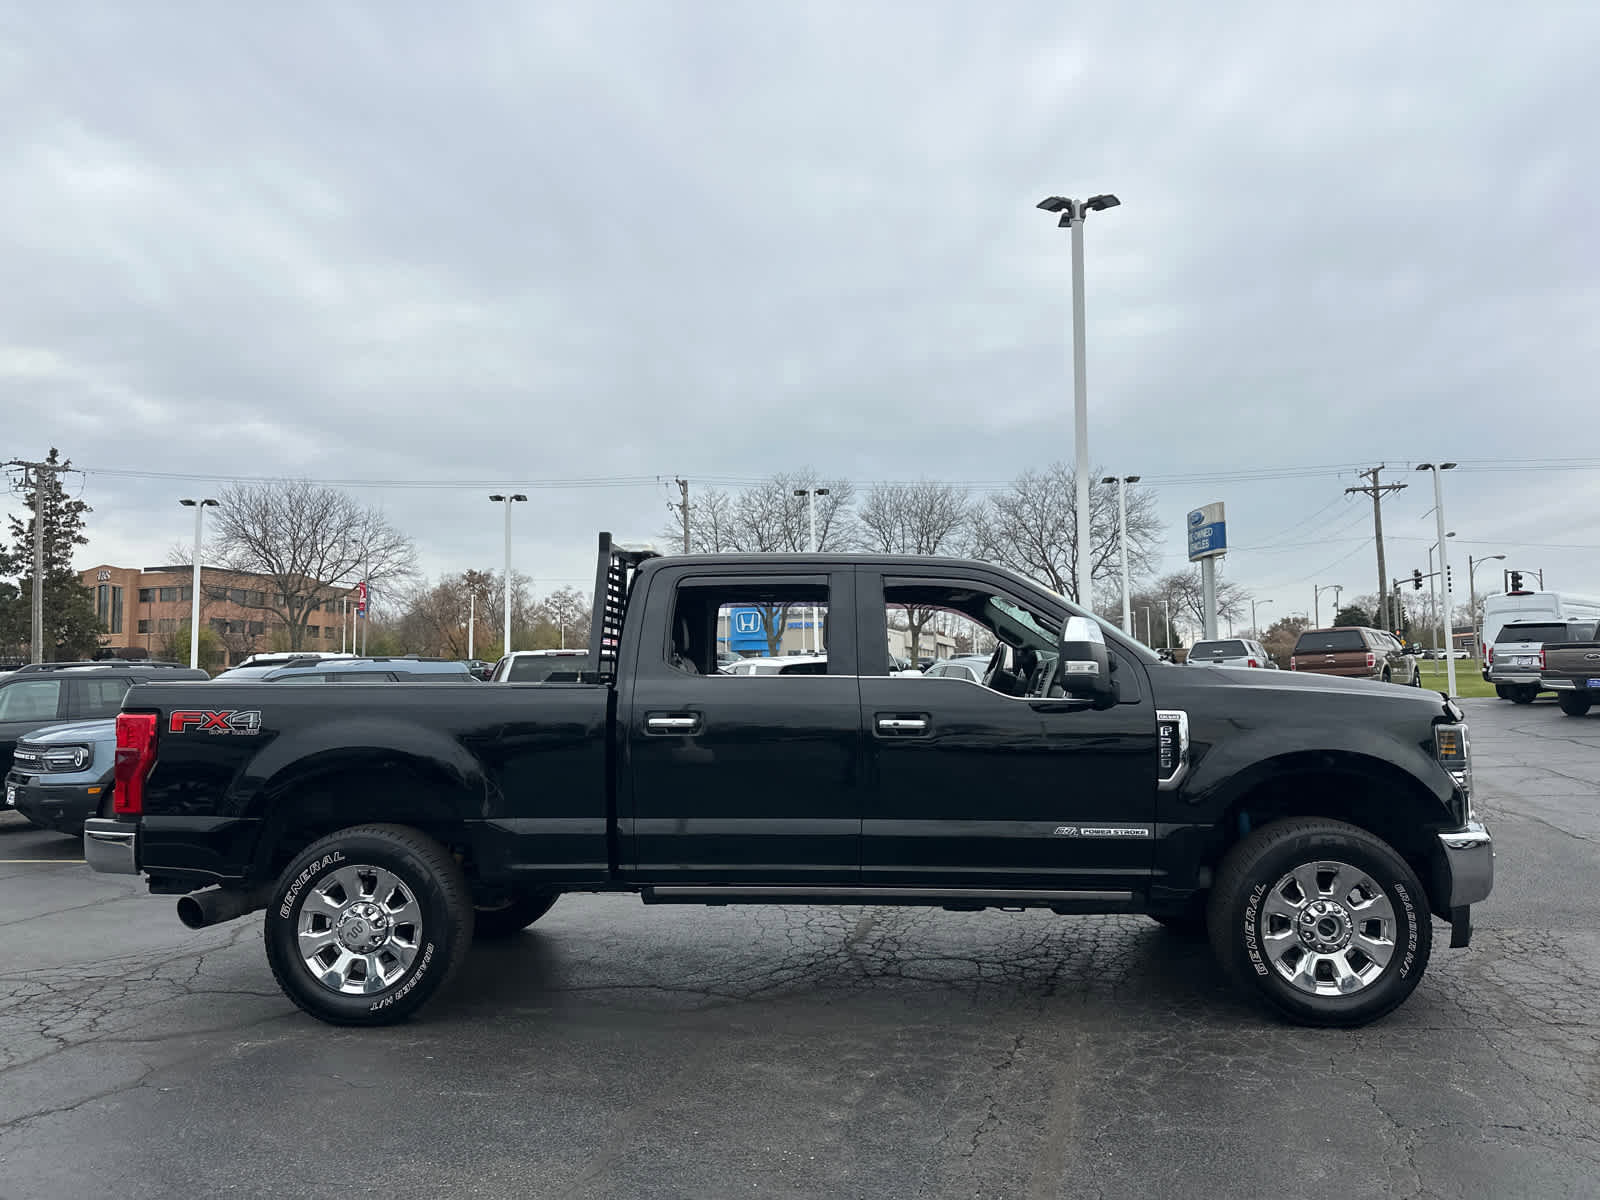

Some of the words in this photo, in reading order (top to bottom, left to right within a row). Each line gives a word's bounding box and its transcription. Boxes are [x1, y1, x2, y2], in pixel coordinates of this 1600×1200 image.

[168, 709, 262, 734] FX4
[1082, 828, 1113, 836] POWER
[1113, 829, 1149, 837] STROKE
[279, 851, 346, 919] GENERAL
[1244, 883, 1269, 976] GENERAL
